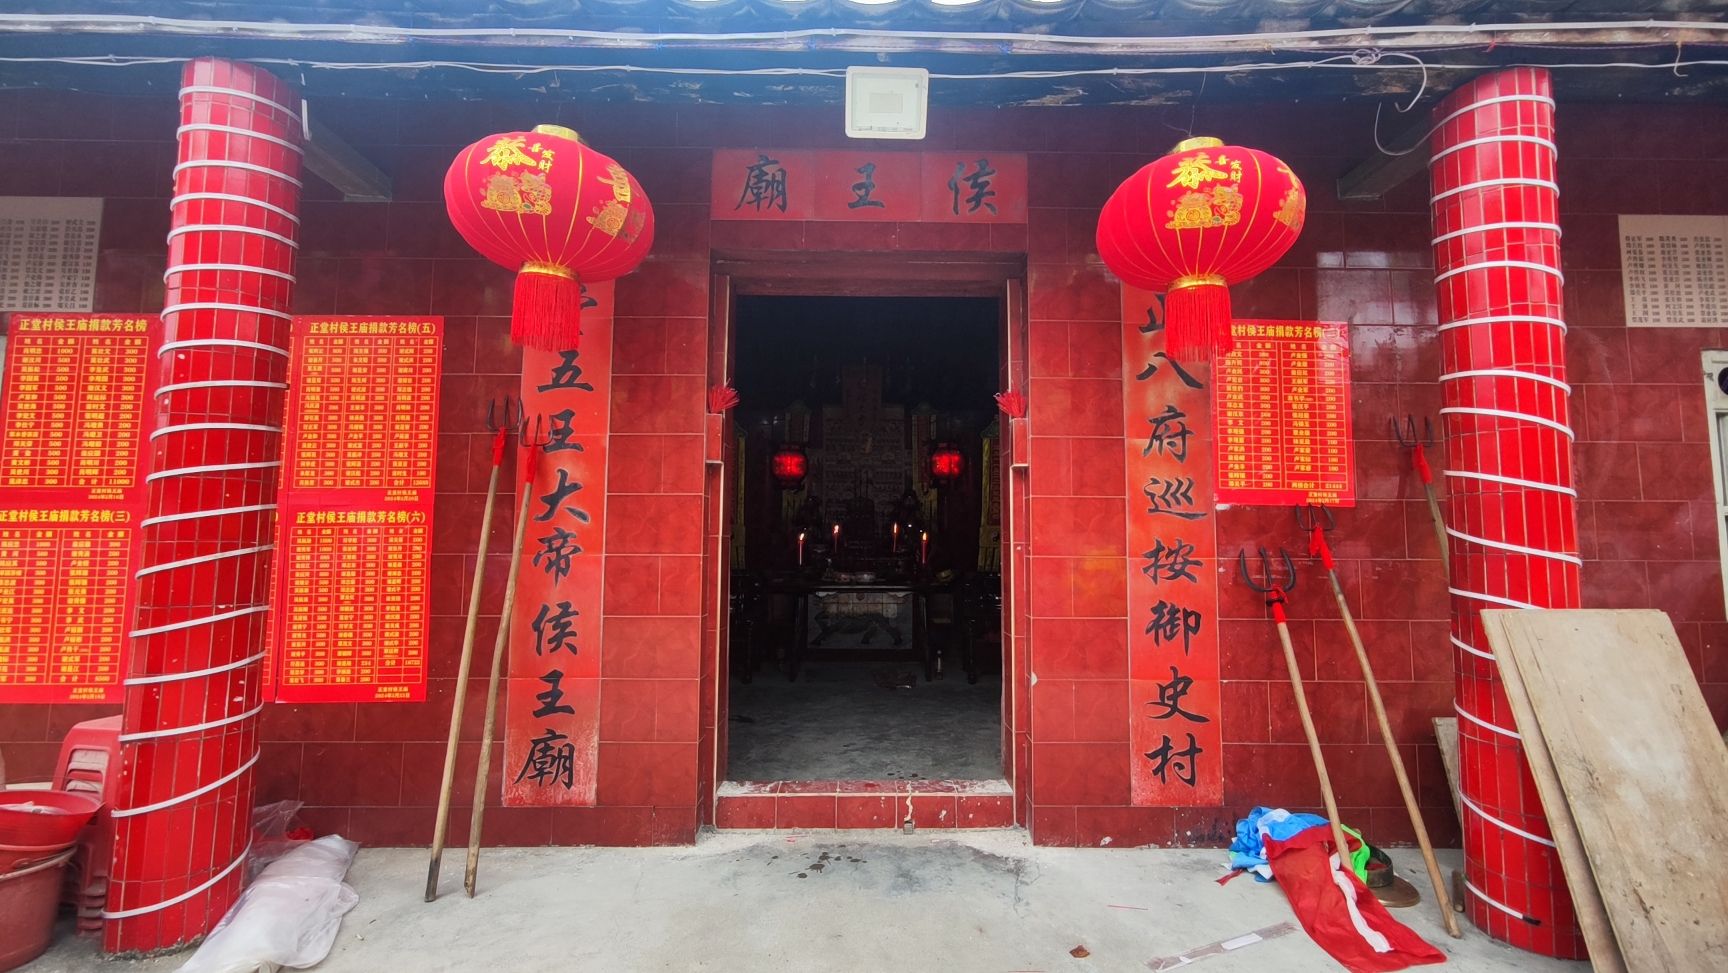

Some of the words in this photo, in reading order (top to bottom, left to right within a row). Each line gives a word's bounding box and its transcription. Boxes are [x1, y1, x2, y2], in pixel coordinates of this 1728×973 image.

[19, 318, 148, 332] 正堂村侯王庙捐款芳名榜
